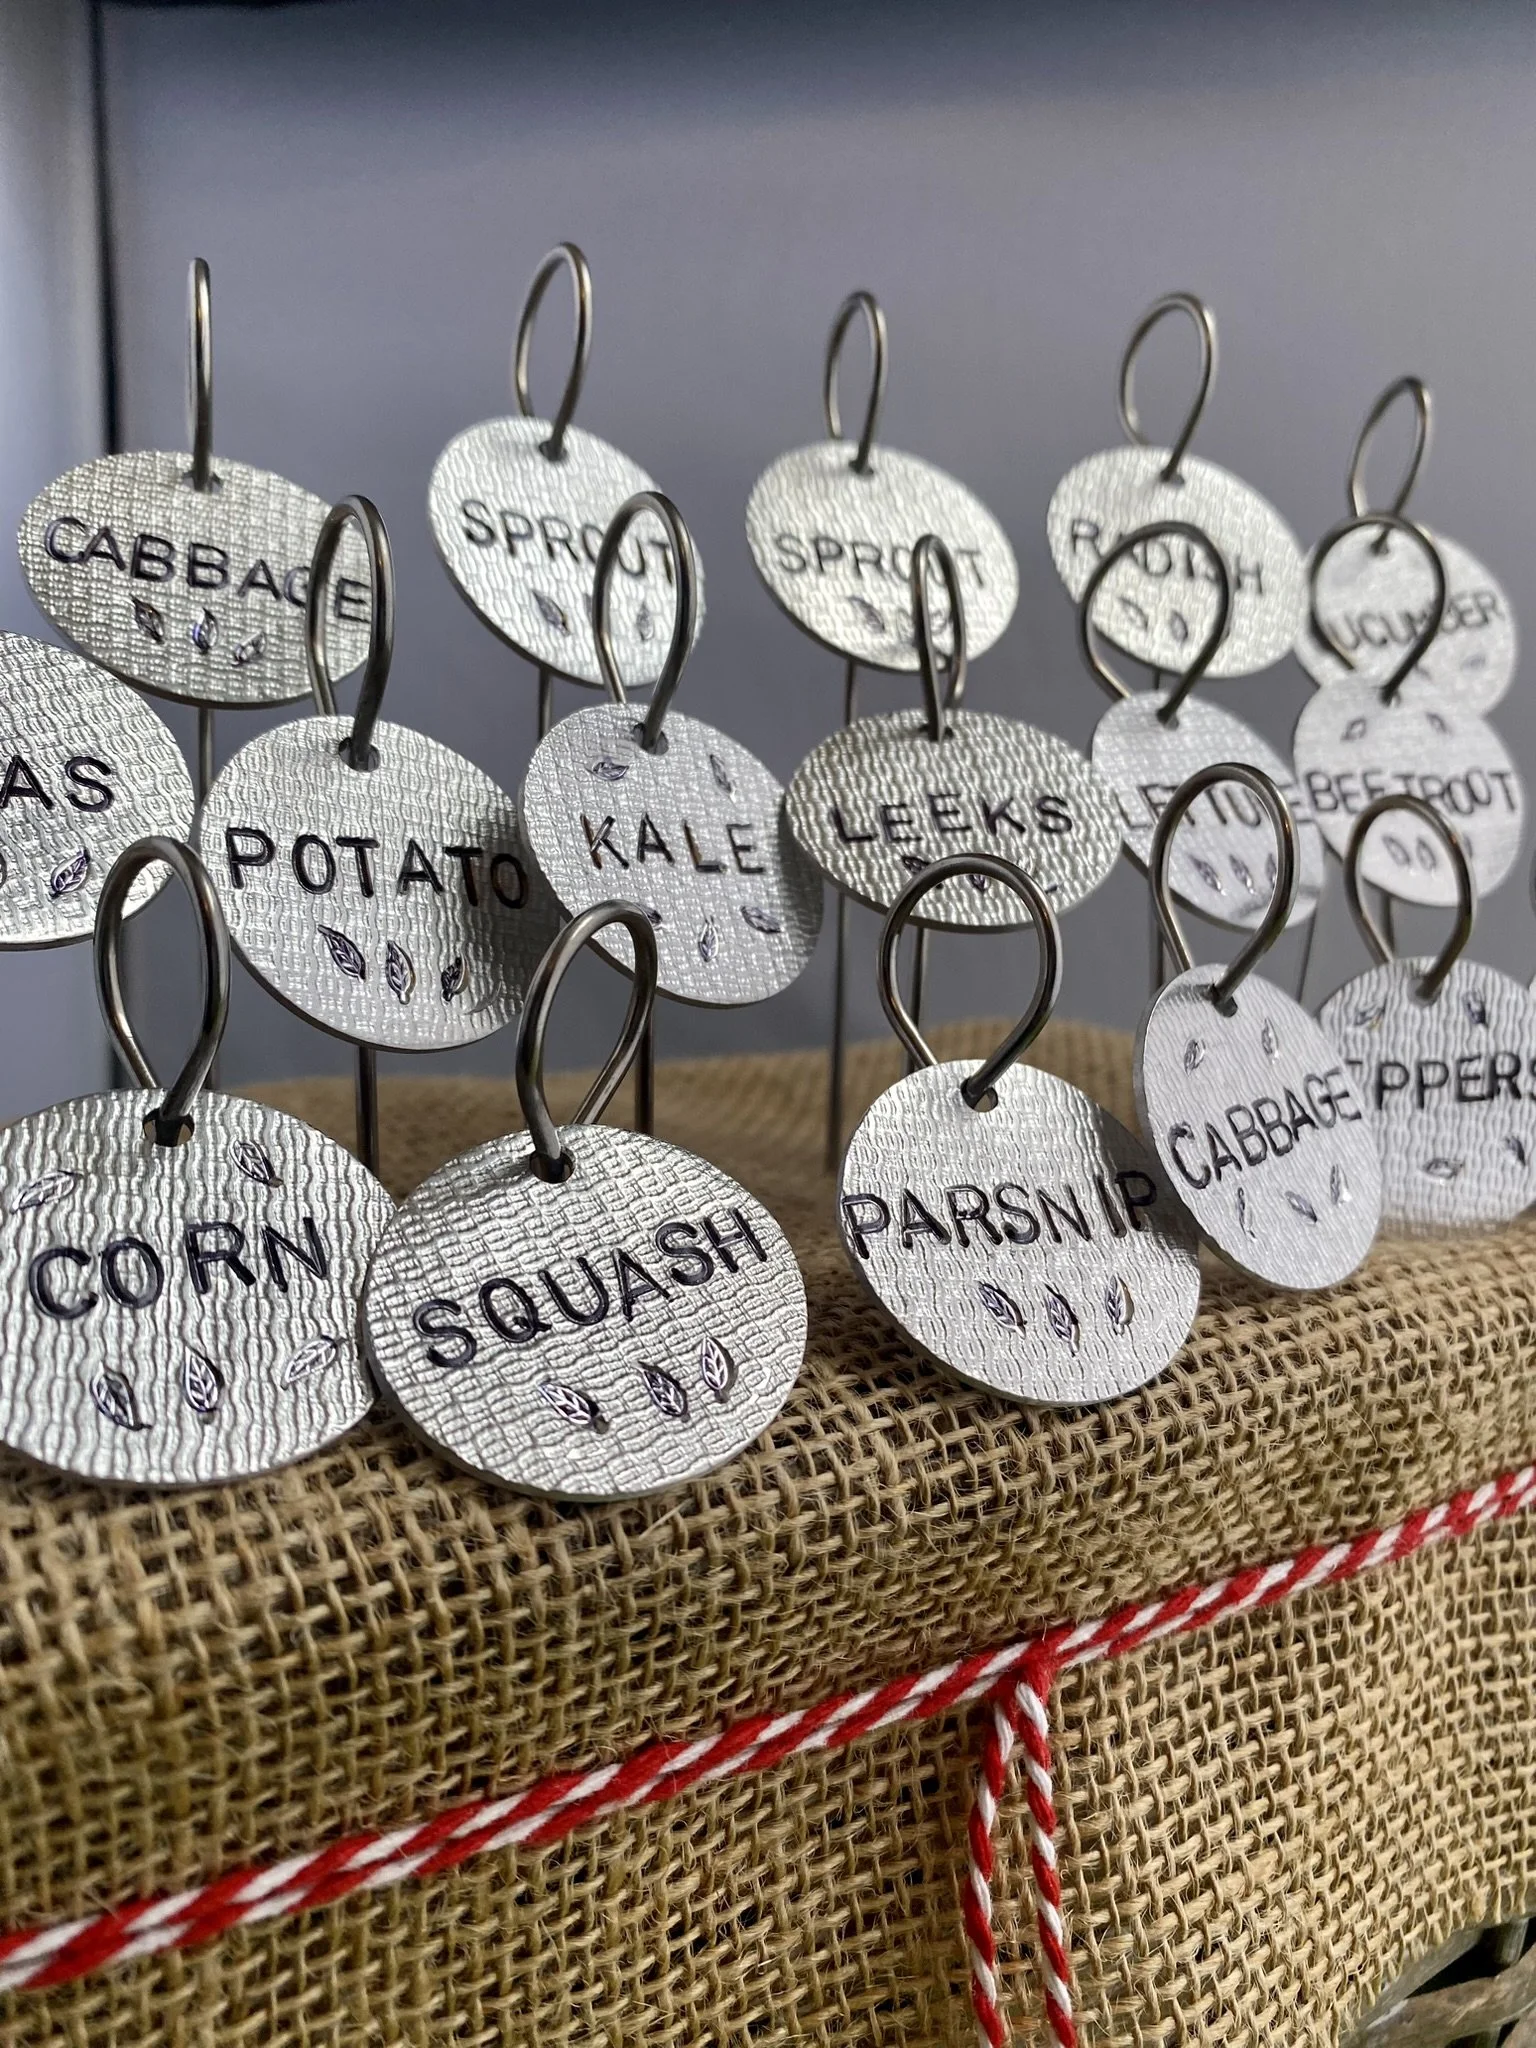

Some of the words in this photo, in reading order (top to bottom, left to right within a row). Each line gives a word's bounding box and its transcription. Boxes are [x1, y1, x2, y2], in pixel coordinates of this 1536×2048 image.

[580, 813, 764, 874] KALE
[831, 794, 1073, 845] LEEKS
[226, 827, 529, 909] POTATO
[1167, 1066, 1362, 1189] CABBAGE
[842, 1170, 1157, 1259] PARSNIP
[28, 1216, 329, 1320] CORN
[412, 1208, 768, 1369] SQUASH
